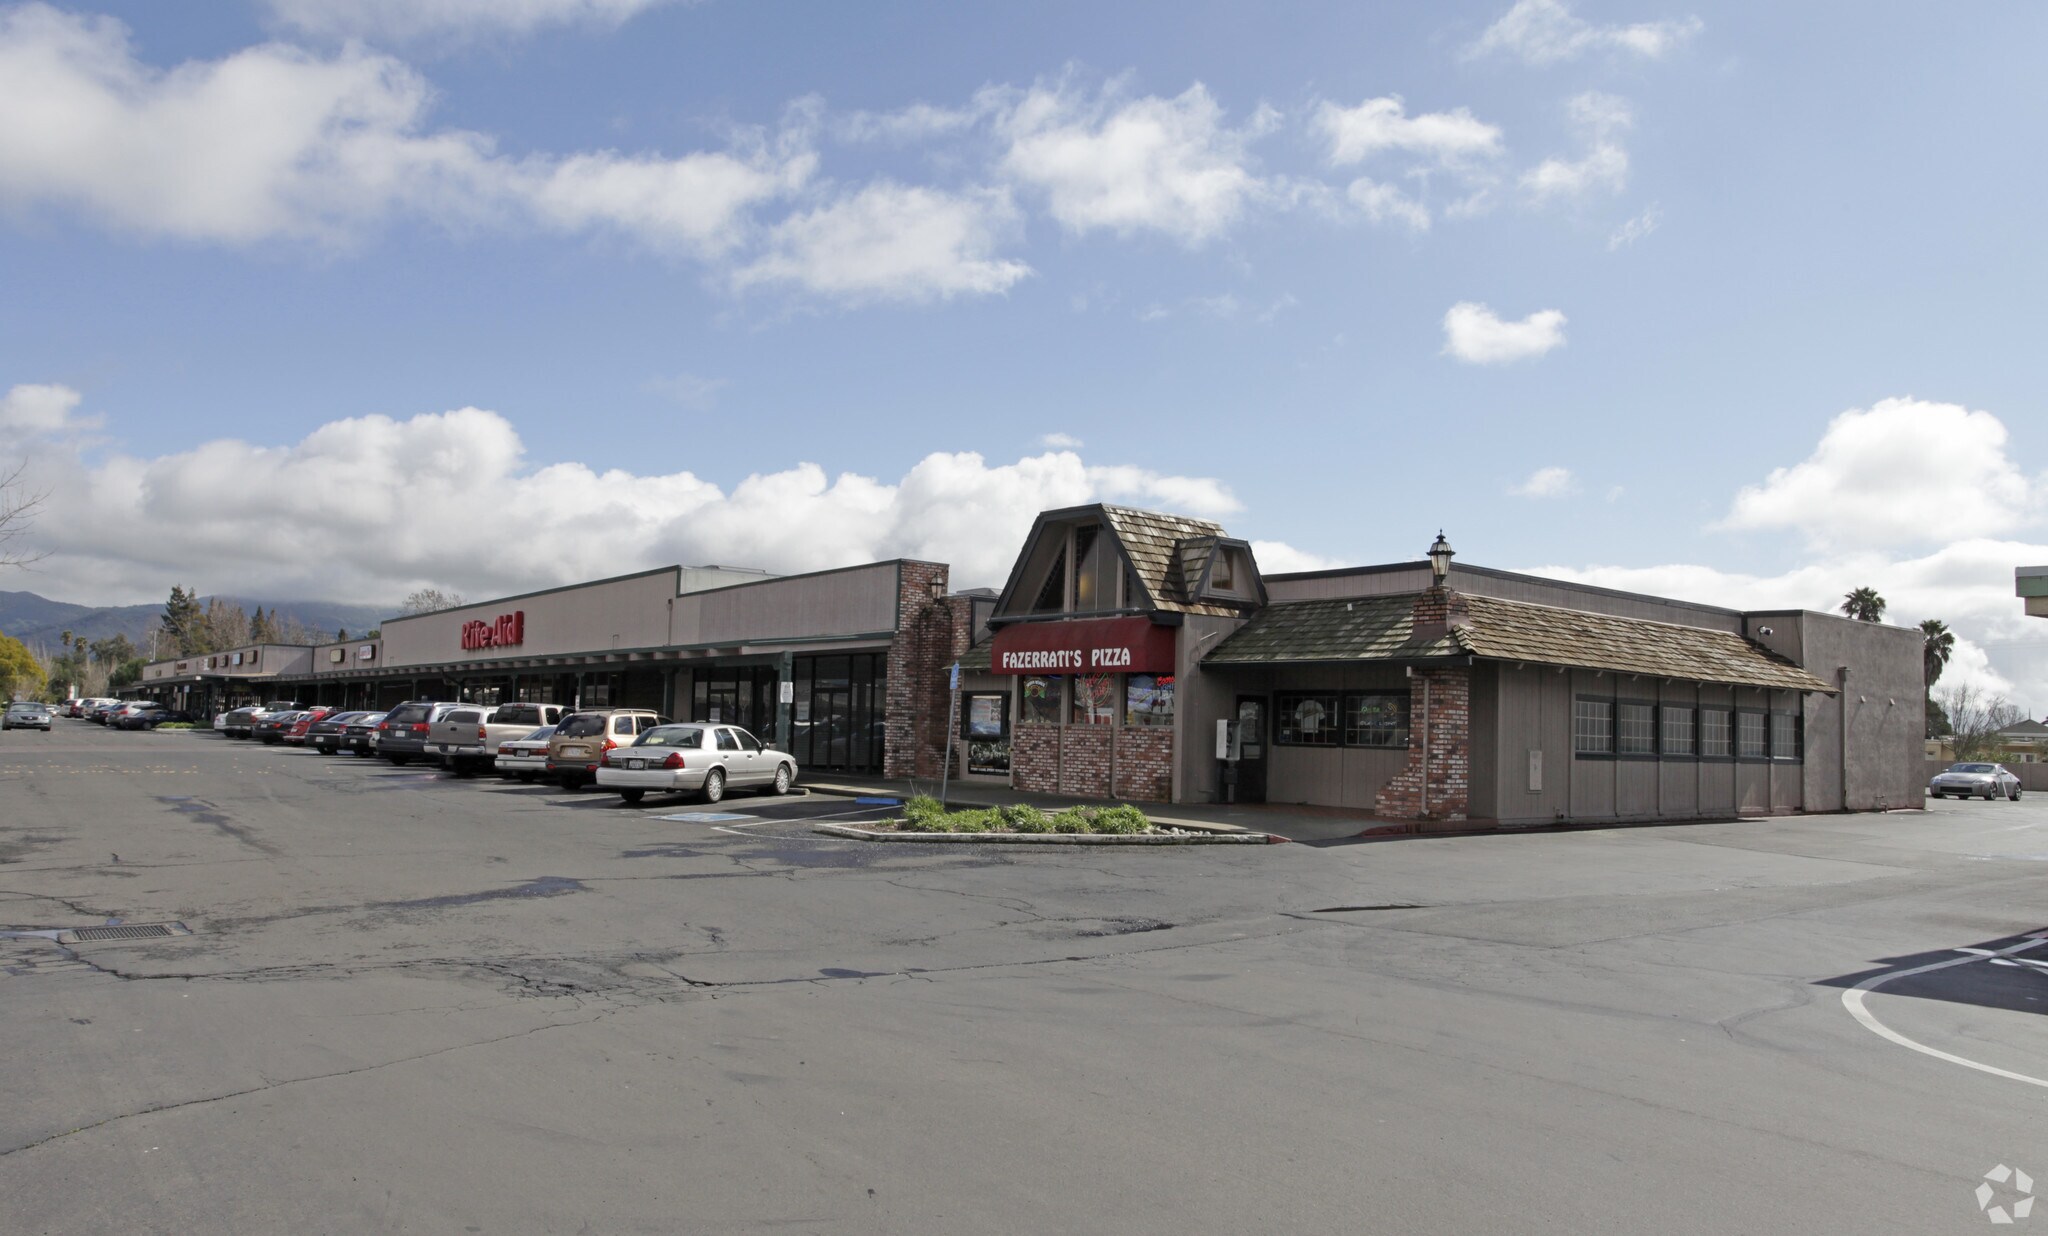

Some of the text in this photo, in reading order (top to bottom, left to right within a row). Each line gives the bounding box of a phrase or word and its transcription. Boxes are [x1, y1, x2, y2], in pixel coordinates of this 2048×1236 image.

[462, 611, 524, 649] Rite Aid
[1002, 647, 1131, 668] FAZERRATI'S PIZZA
